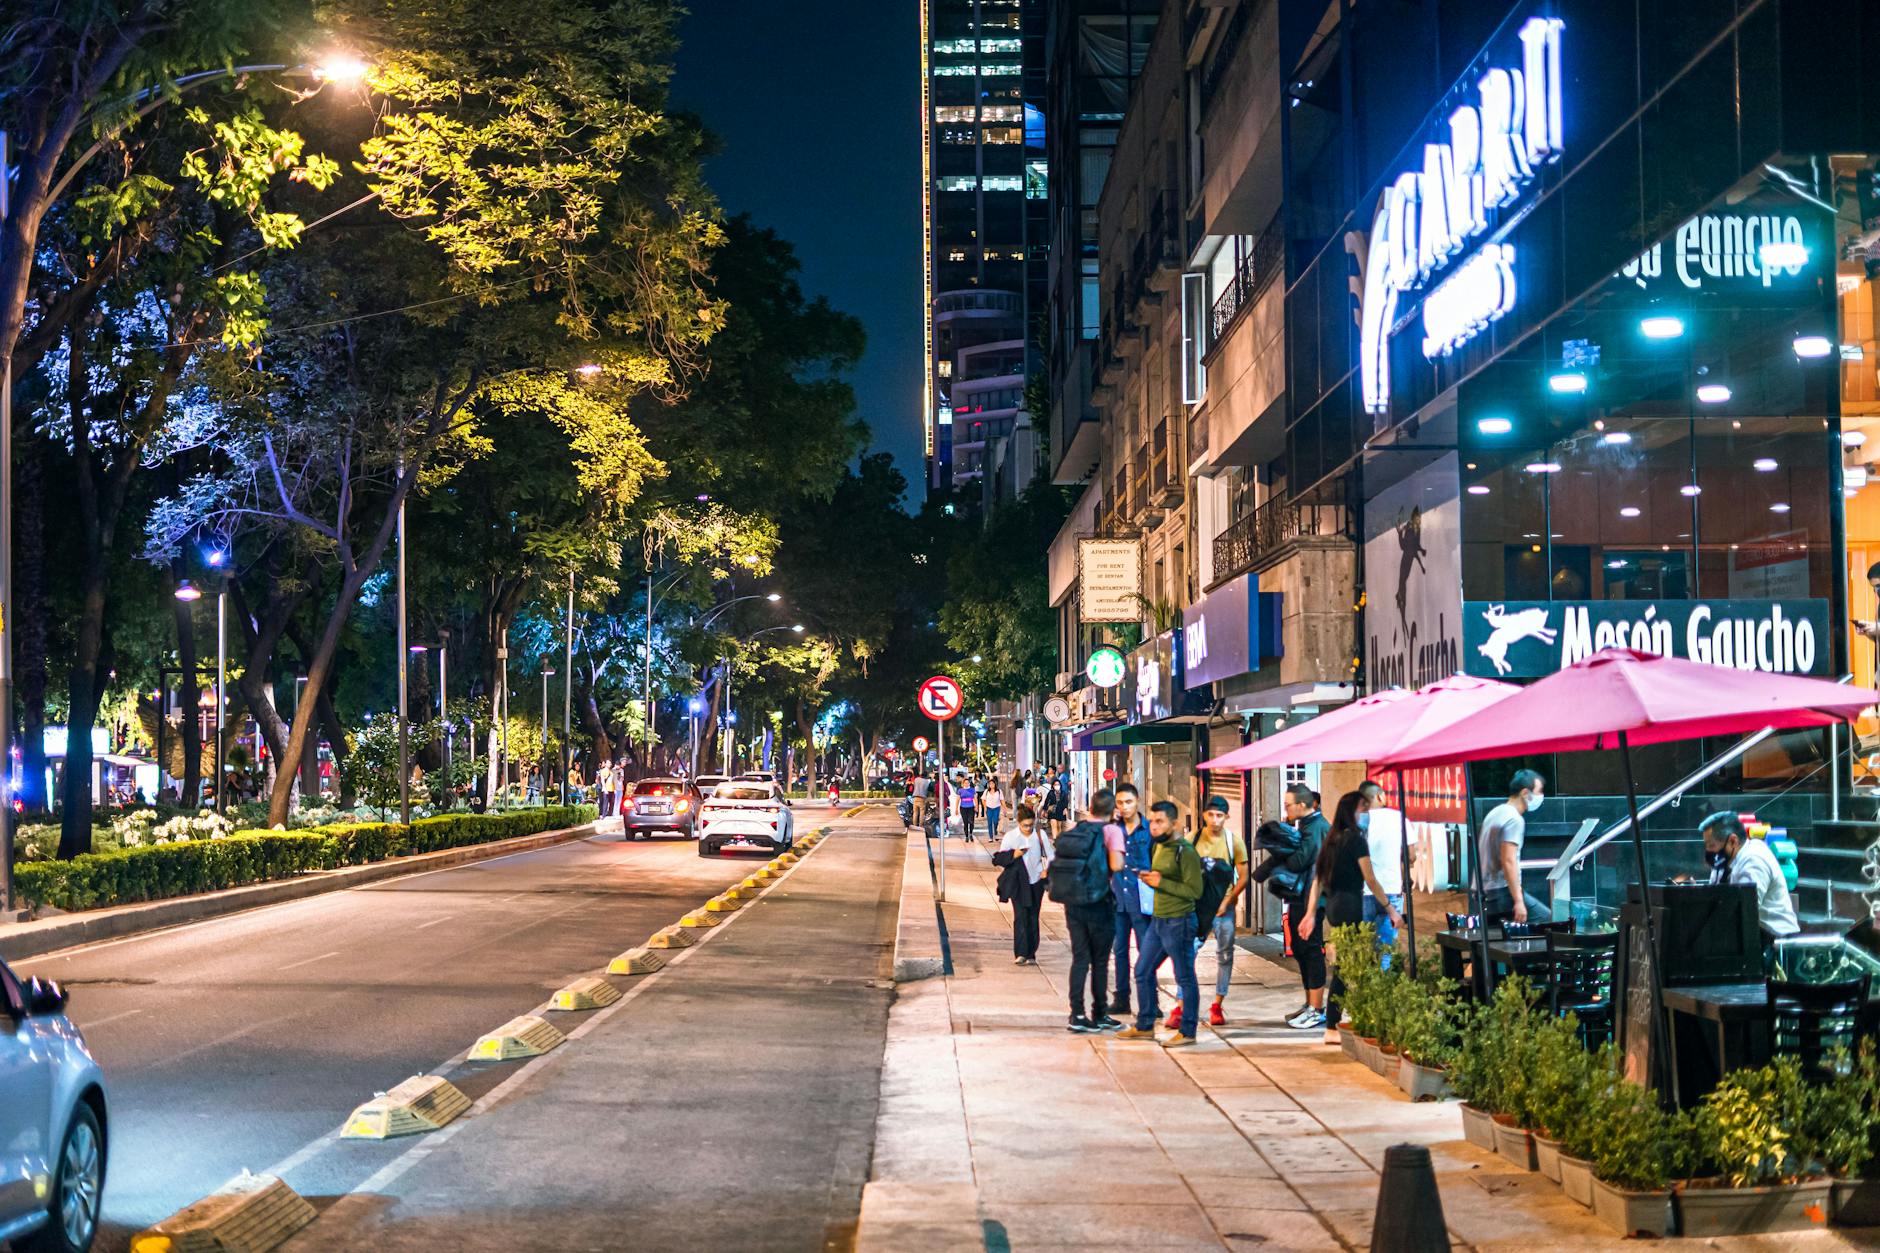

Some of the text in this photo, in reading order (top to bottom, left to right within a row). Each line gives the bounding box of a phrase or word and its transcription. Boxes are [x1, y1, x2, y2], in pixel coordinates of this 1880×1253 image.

[1186, 613, 1208, 670] BBVA
[1560, 603, 1816, 674] Mesón Gaucho
[1372, 766, 1462, 809] EKHOUSE
